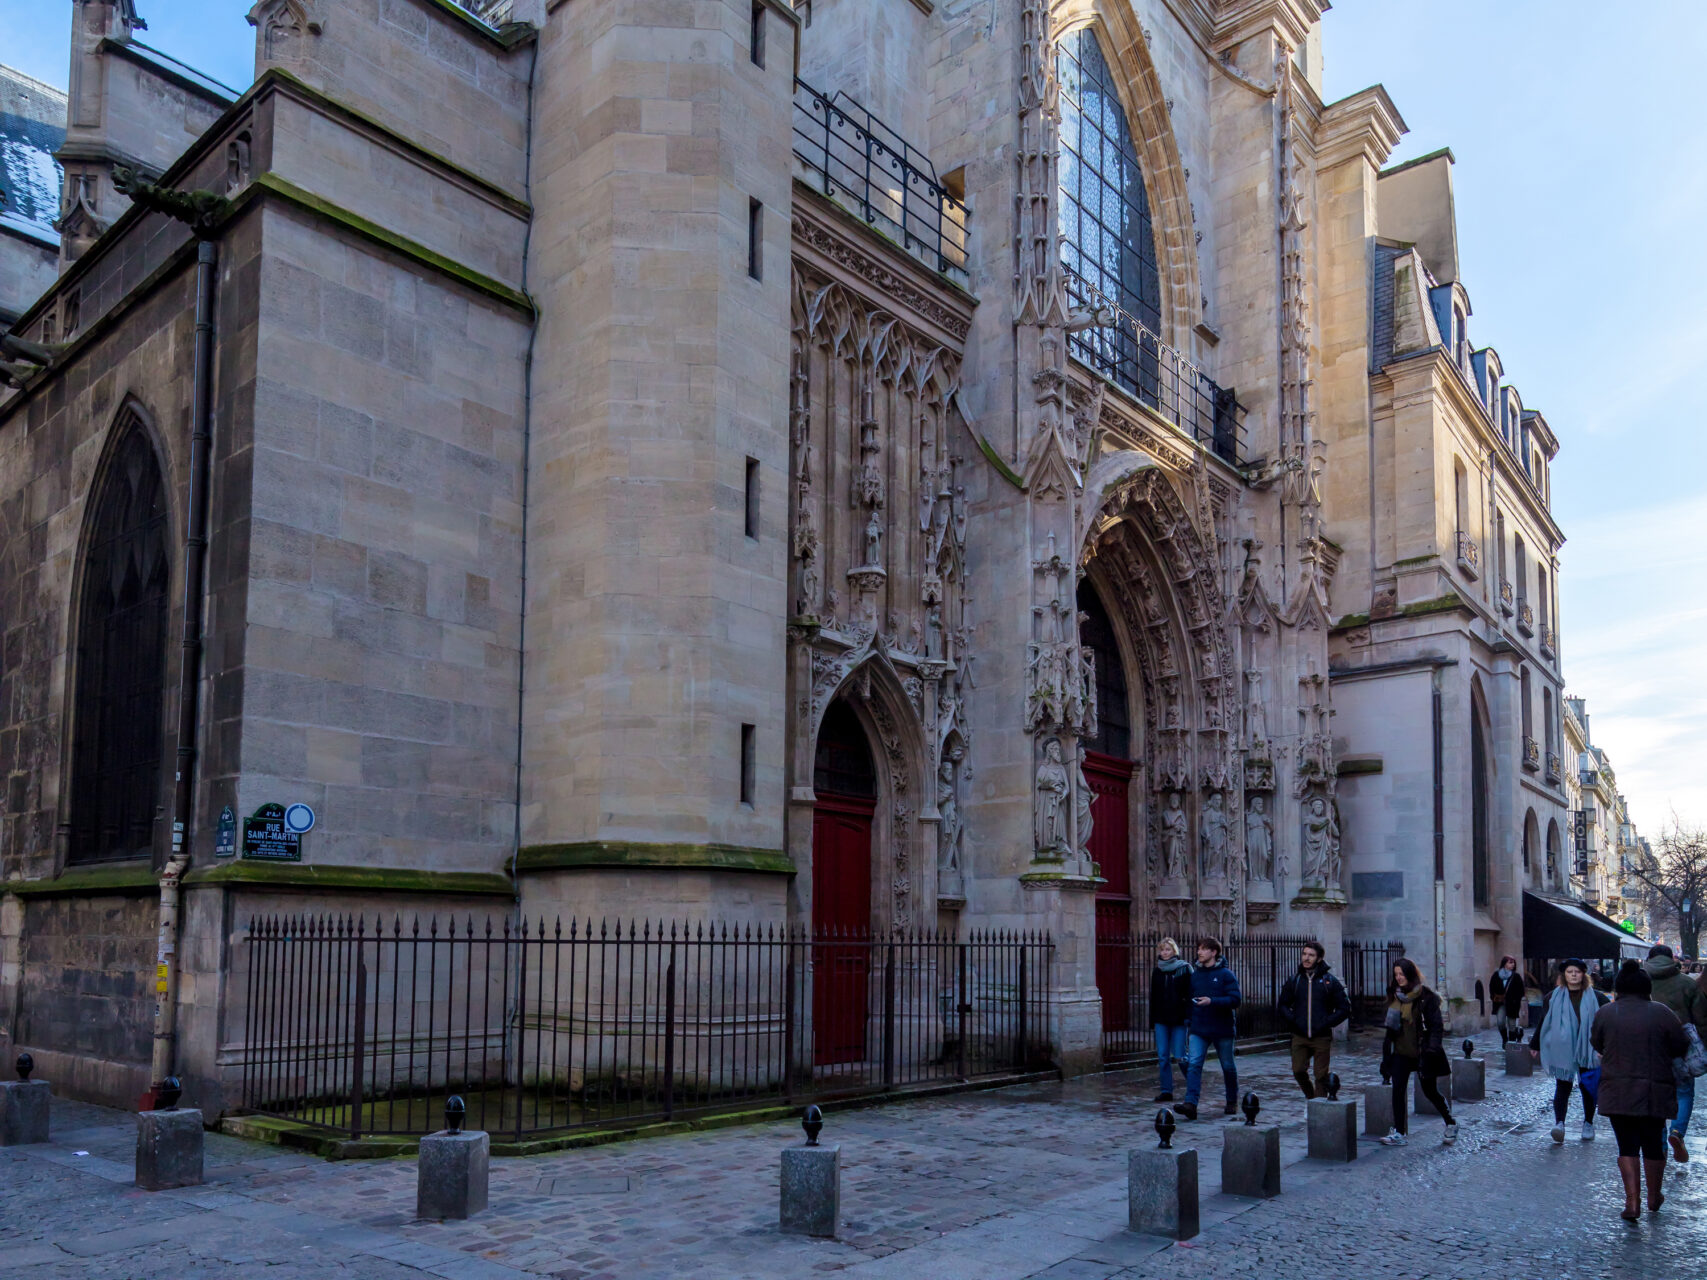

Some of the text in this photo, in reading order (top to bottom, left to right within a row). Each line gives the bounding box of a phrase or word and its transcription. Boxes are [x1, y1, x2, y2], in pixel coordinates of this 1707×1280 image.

[266, 823, 281, 832] RUE
[247, 830, 298, 841] SAINT-MARTIN
[1576, 813, 1587, 873] HOTEL
